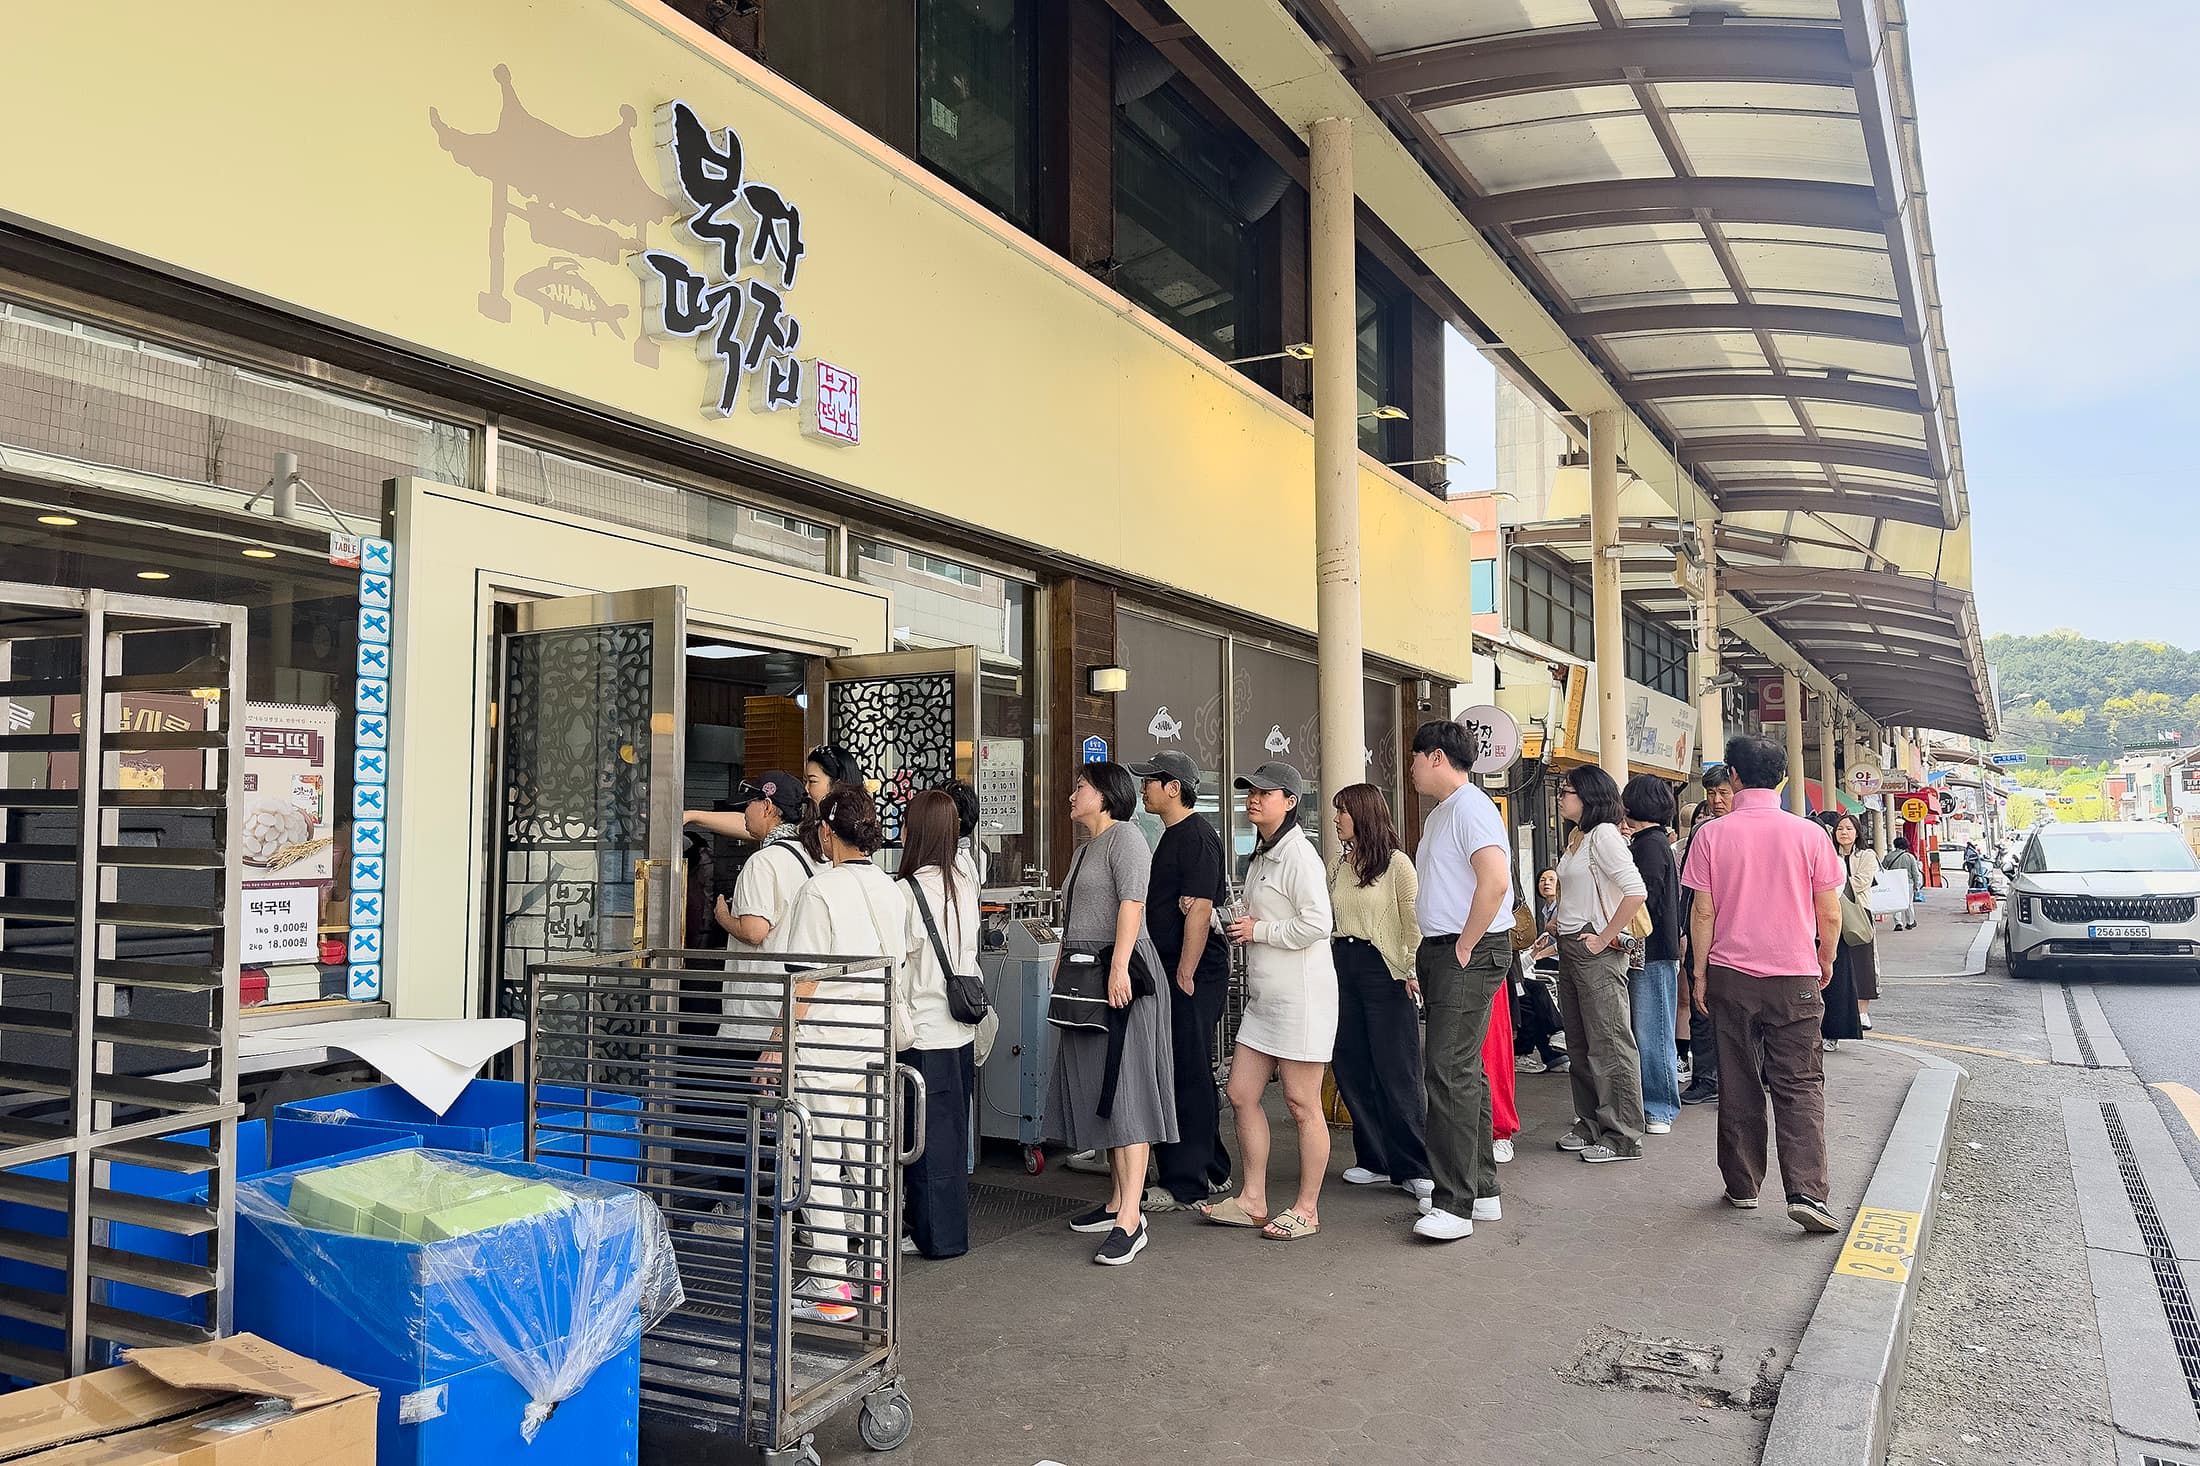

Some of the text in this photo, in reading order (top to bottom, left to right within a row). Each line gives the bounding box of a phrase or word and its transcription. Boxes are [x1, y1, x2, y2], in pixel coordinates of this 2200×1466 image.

[335, 541, 357, 554] TABLE
[1855, 771, 1872, 786] 약
[1907, 801, 1922, 818] 닭
[250, 900, 291, 916] 떡국떡
[255, 927, 269, 935] 1kg
[2124, 928, 2148, 937] 6555
[249, 943, 263, 951] 2kg
